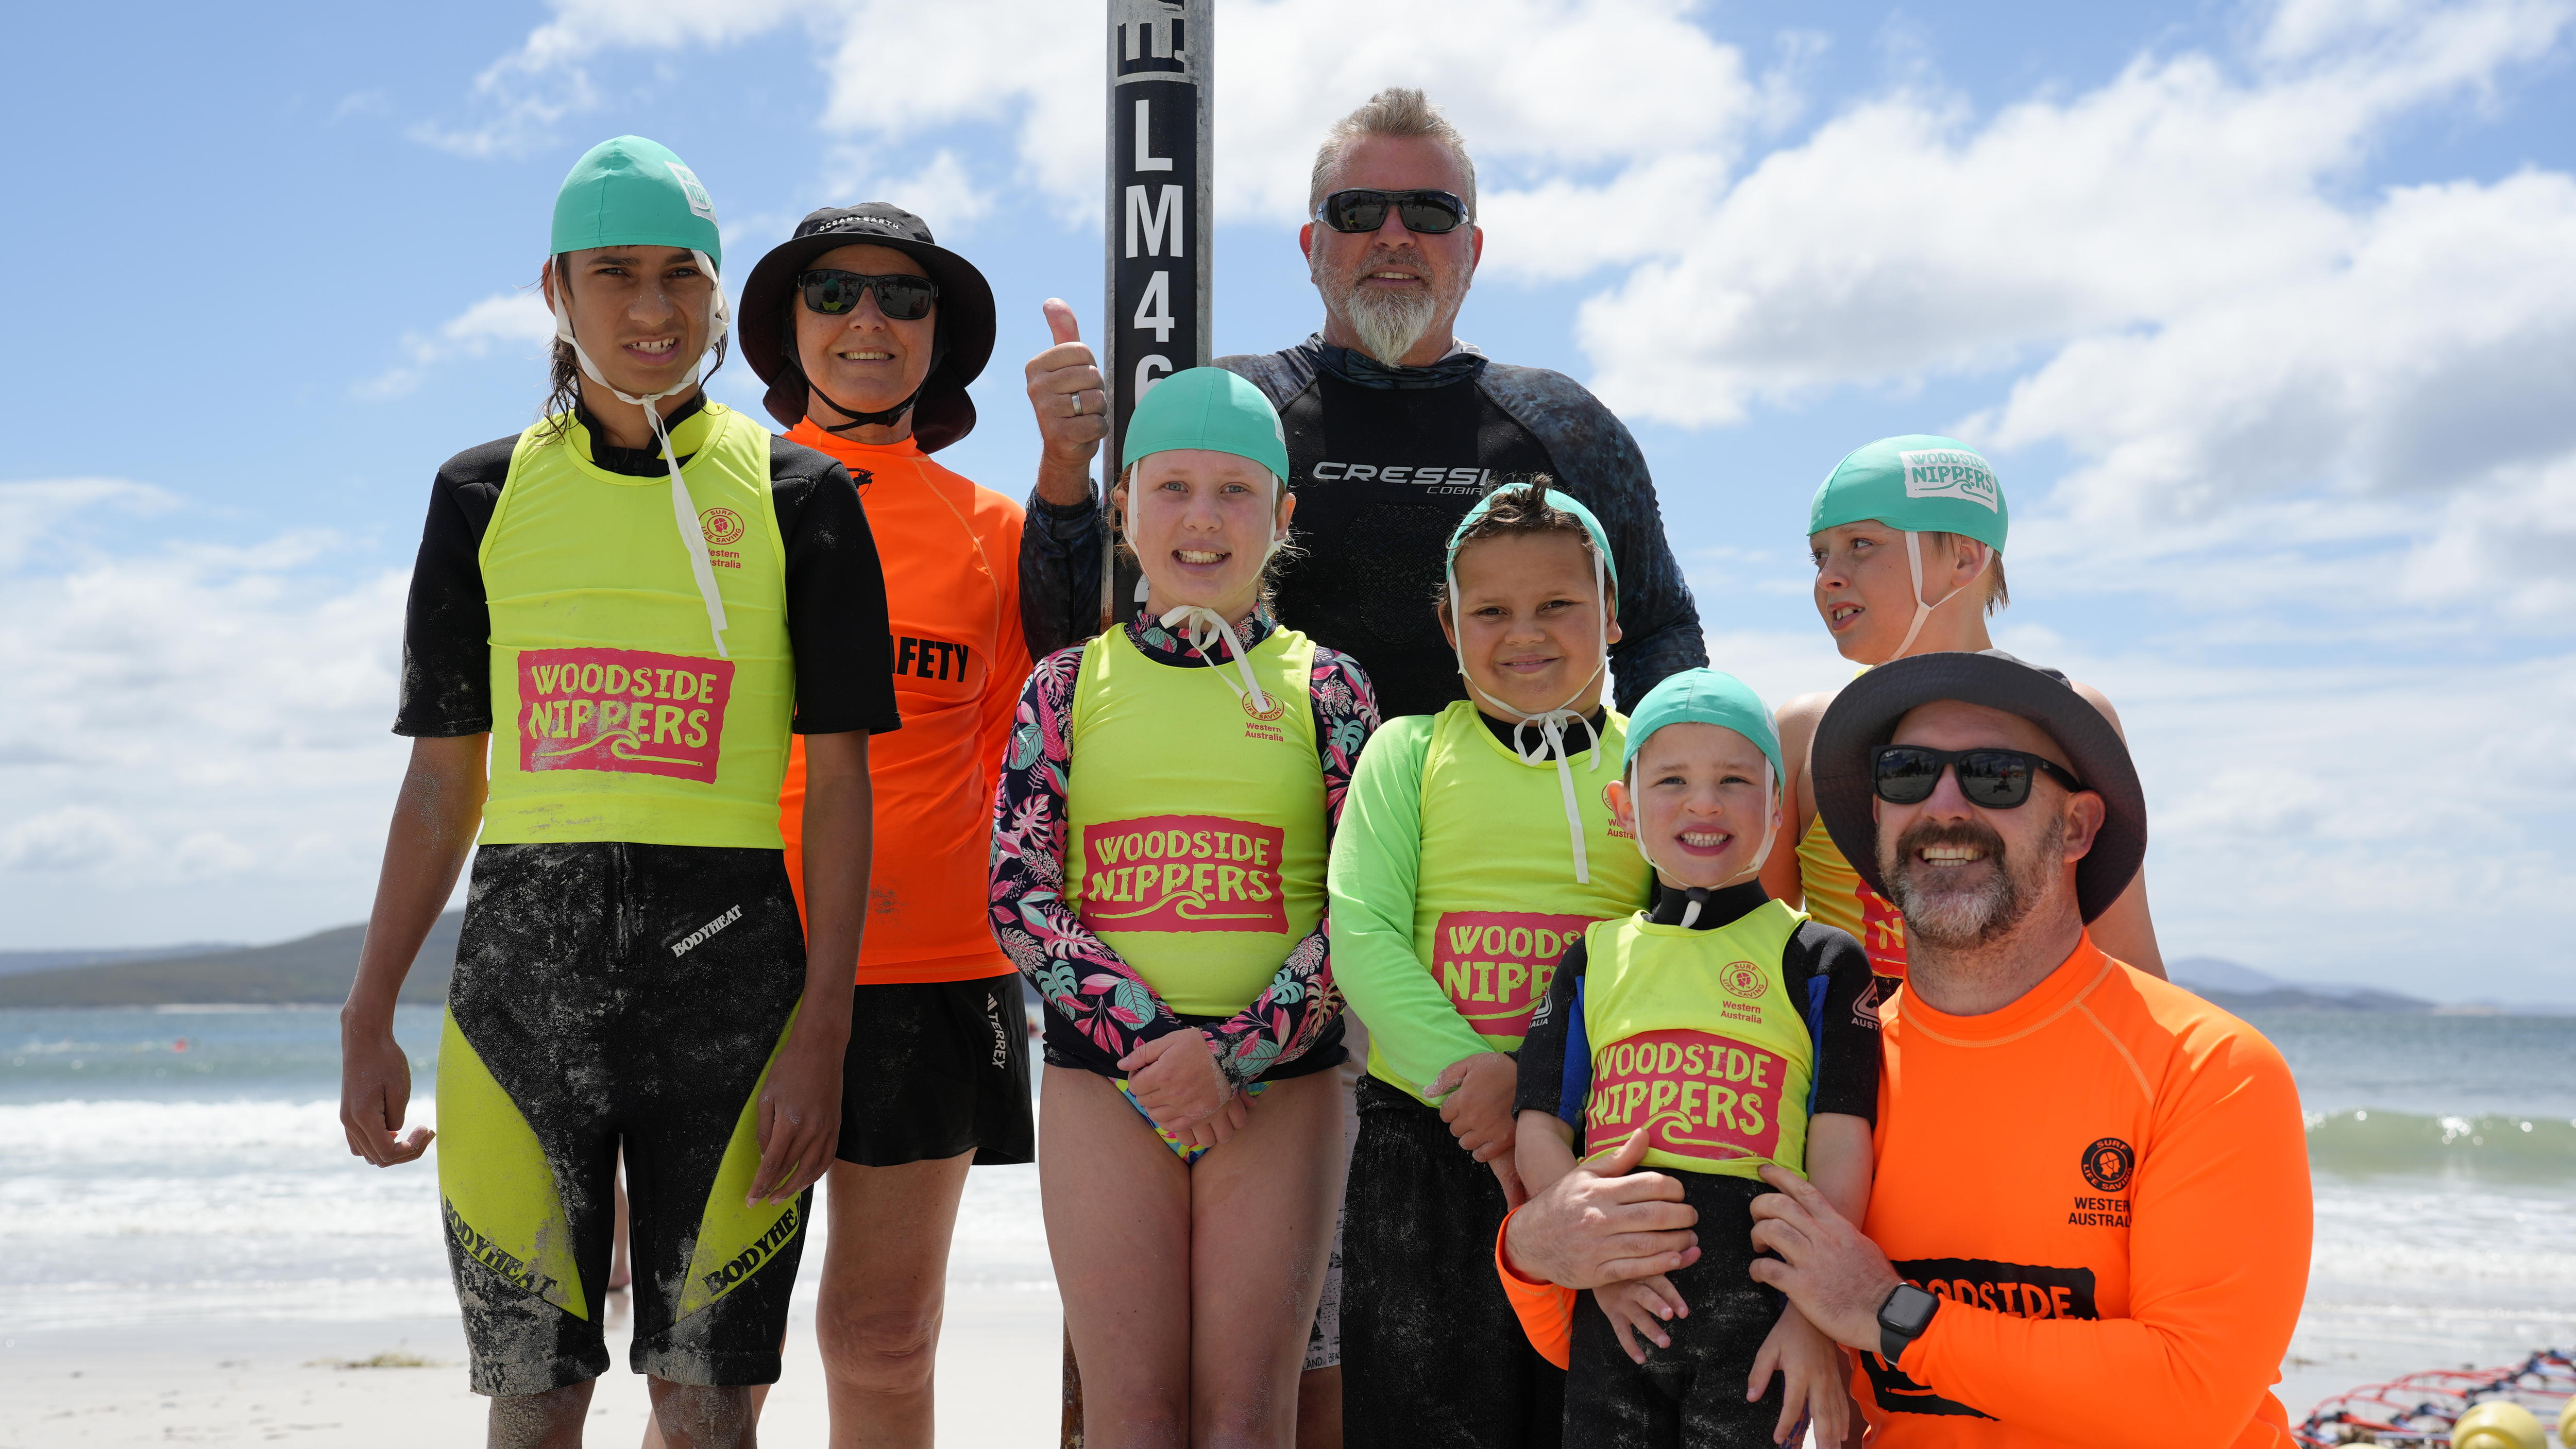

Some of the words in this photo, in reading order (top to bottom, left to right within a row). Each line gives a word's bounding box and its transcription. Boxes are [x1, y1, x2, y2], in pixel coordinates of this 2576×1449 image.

[820, 217, 899, 232] OCEAN+EARTH
[1312, 462, 1491, 486] CRESSI
[1911, 465, 1994, 493] NIPPERS
[1426, 486, 1483, 496] COBIA
[716, 528, 741, 542] SAVING
[708, 549, 739, 558] estern
[710, 559, 741, 569] stralia
[890, 635, 969, 683] FETY
[531, 663, 717, 704] WOODSIDE
[529, 699, 709, 748] NIPPERS
[1245, 703, 1257, 716] LIFE
[1258, 707, 1282, 720] SAVING
[1245, 730, 1284, 742] Australia
[1246, 722, 1281, 732] Western
[1095, 830, 1270, 866] WOODSIDE
[1088, 863, 1273, 902] NIPPERS
[671, 904, 742, 958] BODYHEAT
[1449, 926, 1582, 959] WOODS
[1443, 961, 1557, 1003] NIPP
[1721, 1010, 1762, 1024] Australia
[1722, 1000, 1761, 1014] Western
[1529, 1018, 1549, 1029] ALIA
[1851, 1017, 1879, 1031] AUST
[988, 1012, 1006, 1069] TERREX
[1597, 1042, 1771, 1088] WOODSIDE
[1589, 1080, 1765, 1135] NIPPERS
[2096, 1139, 2128, 1151] SURF
[2083, 1164, 2099, 1186] LIFE
[2102, 1167, 2132, 1190] SAVING
[446, 1195, 558, 1299] BODYHEAT
